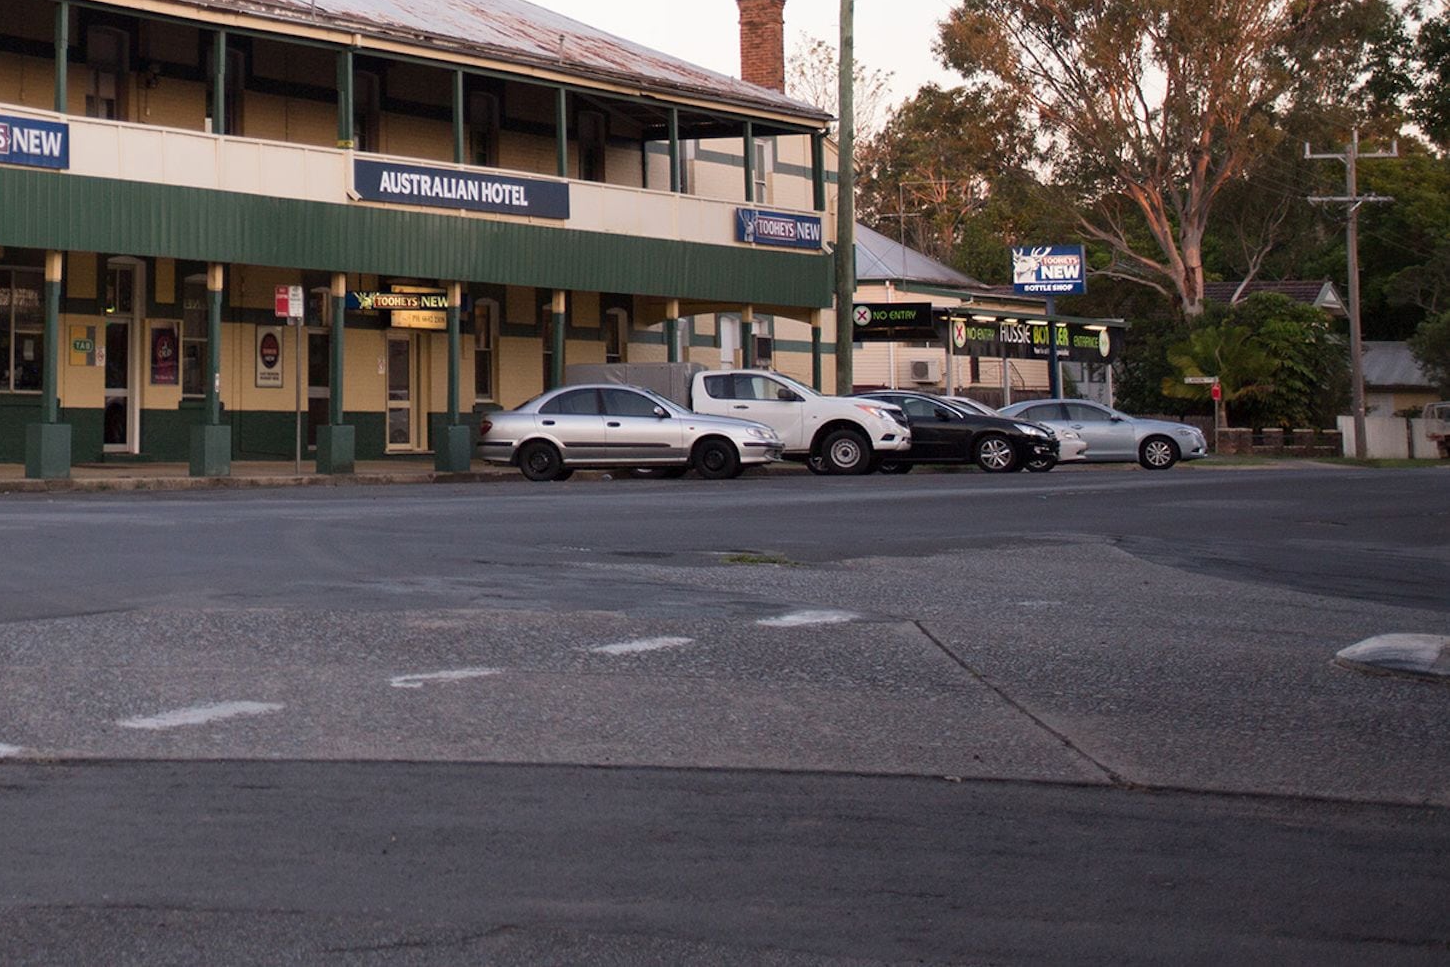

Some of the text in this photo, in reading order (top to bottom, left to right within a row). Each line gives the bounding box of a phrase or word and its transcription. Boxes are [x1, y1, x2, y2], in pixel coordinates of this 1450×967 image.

[12, 127, 61, 156] NEW
[380, 171, 529, 206] AUSTRALIAN HOTEL
[758, 220, 820, 241] TOOHEYS NEW
[1043, 256, 1079, 264] TOOHEYS
[1041, 265, 1079, 279] NEW
[1024, 284, 1074, 292] BOTTLE SHOP
[377, 296, 448, 308] TOOHEYS NEW
[873, 310, 916, 320] NO ENTRY
[967, 327, 994, 341] NO ENTRY
[1000, 324, 1030, 344] AUSSIE
[76, 341, 90, 349] TAB
